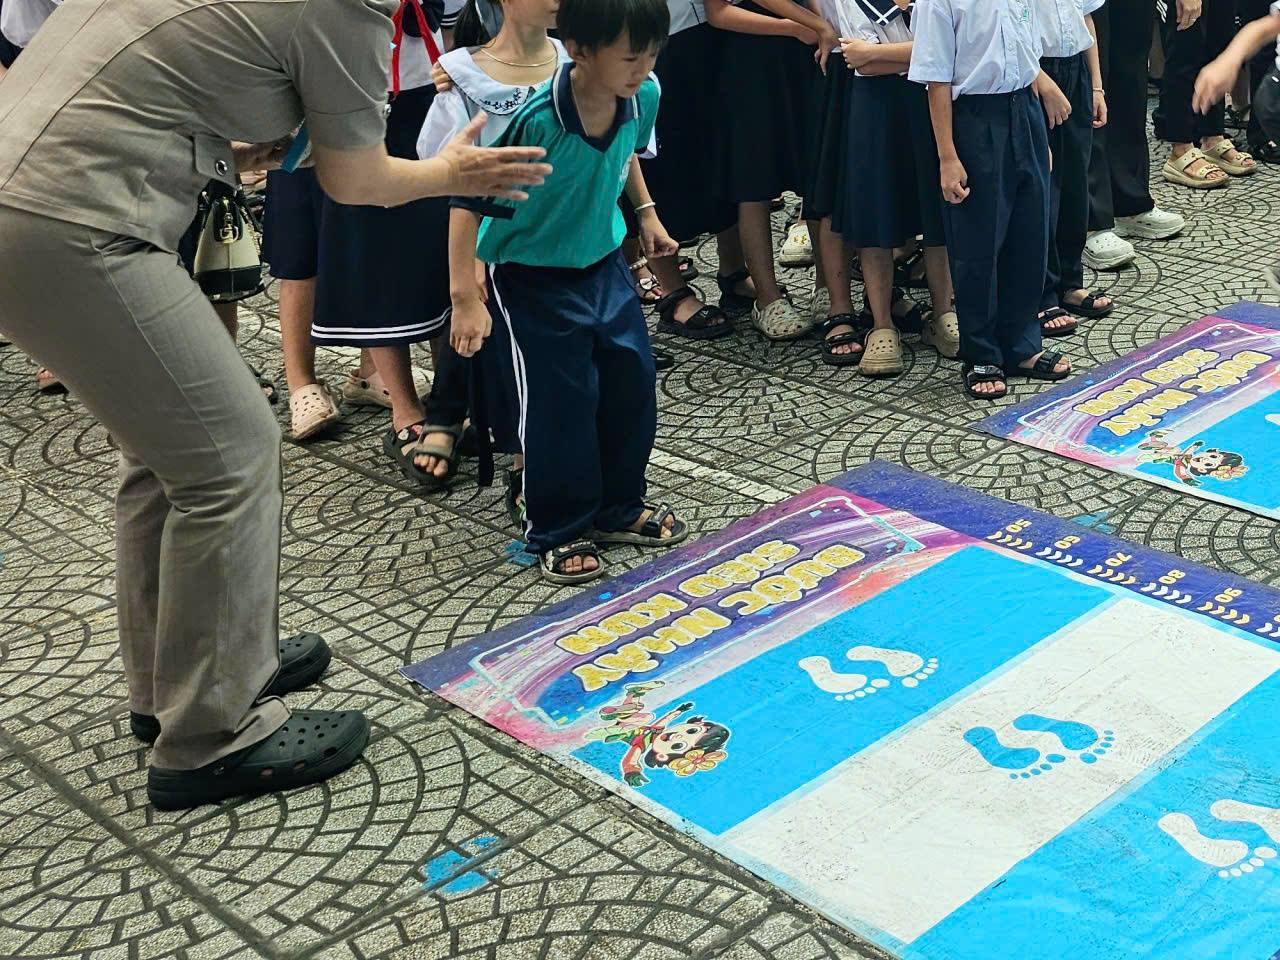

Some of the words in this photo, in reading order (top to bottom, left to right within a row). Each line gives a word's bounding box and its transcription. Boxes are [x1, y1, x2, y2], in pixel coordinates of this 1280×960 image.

[1006, 518, 1031, 533] 50
[1056, 535, 1080, 549] 60
[1106, 552, 1132, 567] 70
[678, 539, 802, 598] SIÊU
[718, 543, 867, 616] BƯỚC
[1160, 569, 1186, 584] 80
[1214, 588, 1242, 603] 90
[554, 592, 688, 656] KUN
[572, 606, 732, 692] NHẢY
